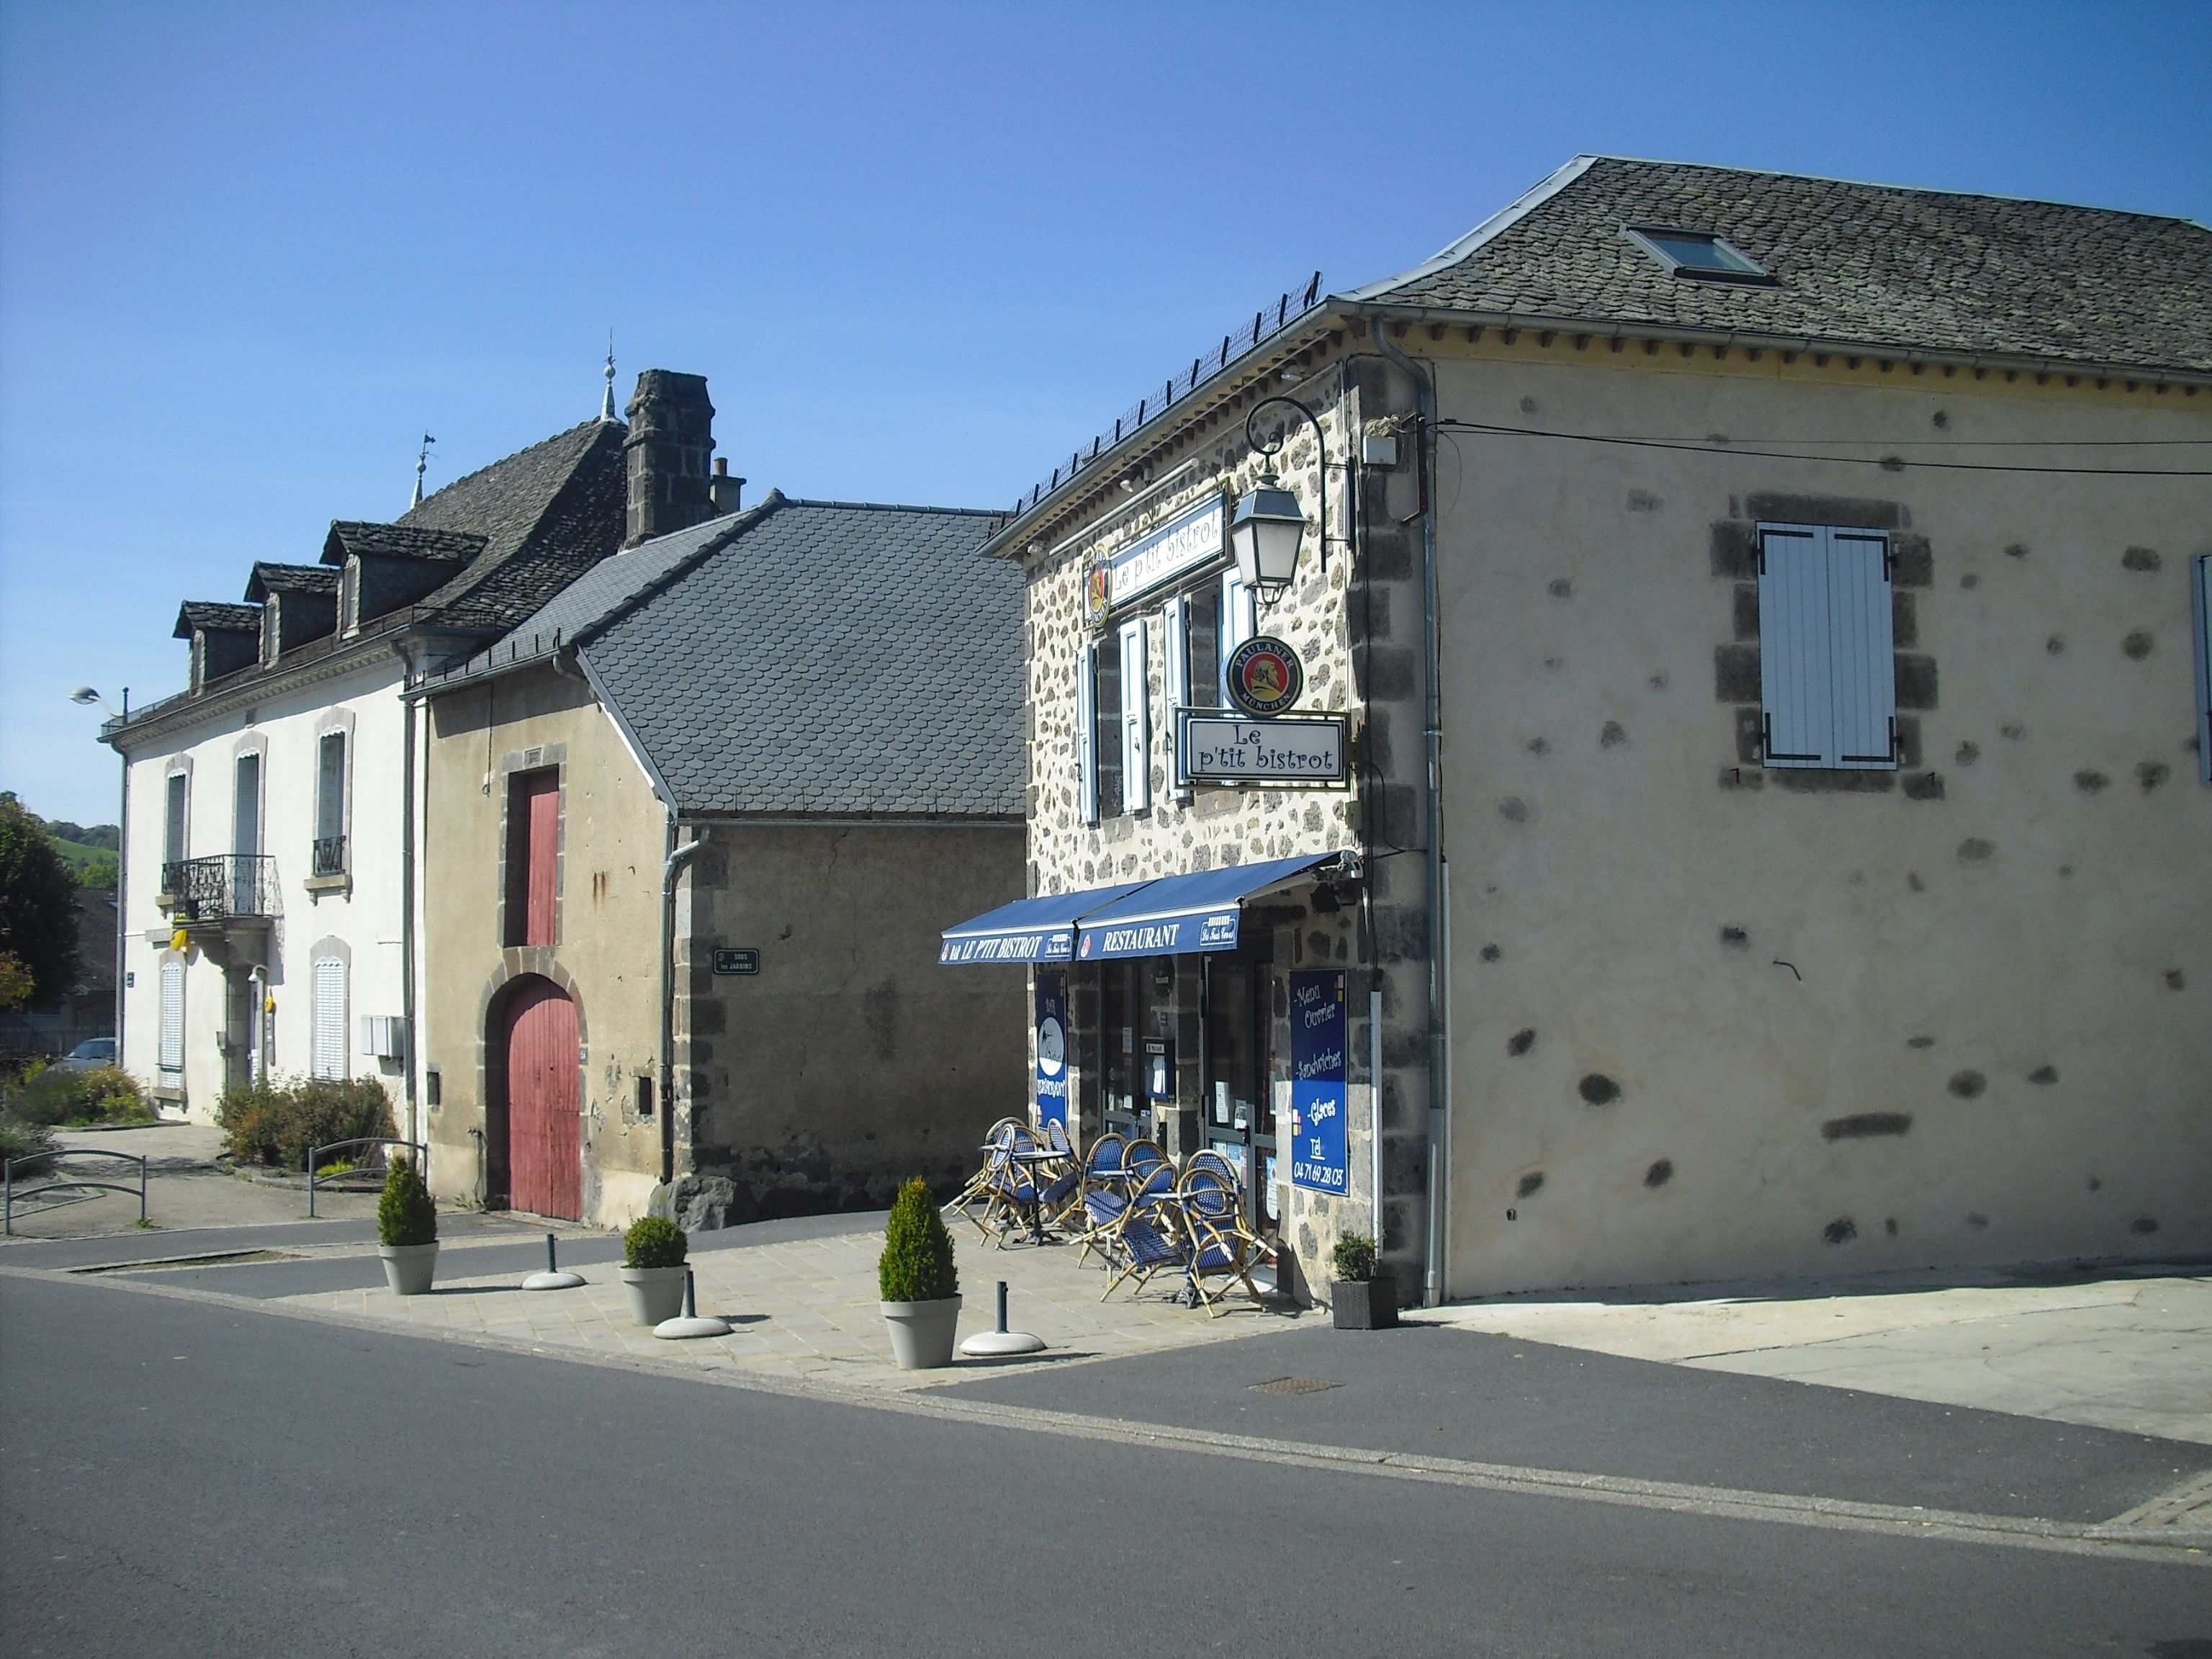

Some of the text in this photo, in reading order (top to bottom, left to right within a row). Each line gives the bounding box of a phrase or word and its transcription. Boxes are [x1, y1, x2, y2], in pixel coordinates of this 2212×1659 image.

[1115, 509, 1218, 590] Le p'tit bistrot
[1236, 643, 1295, 668] PAULANER
[1233, 724, 1261, 745] Le
[1199, 745, 1333, 771] p'tit bistrot
[961, 940, 976, 960] LE
[973, 938, 1001, 958] P'TIT
[996, 936, 1043, 958] BISTROT
[1102, 924, 1180, 952] RESTAURANT
[1305, 1002, 1335, 1028] Ouvrier
[1294, 1161, 1343, 1186] 04 71 69 28 03
